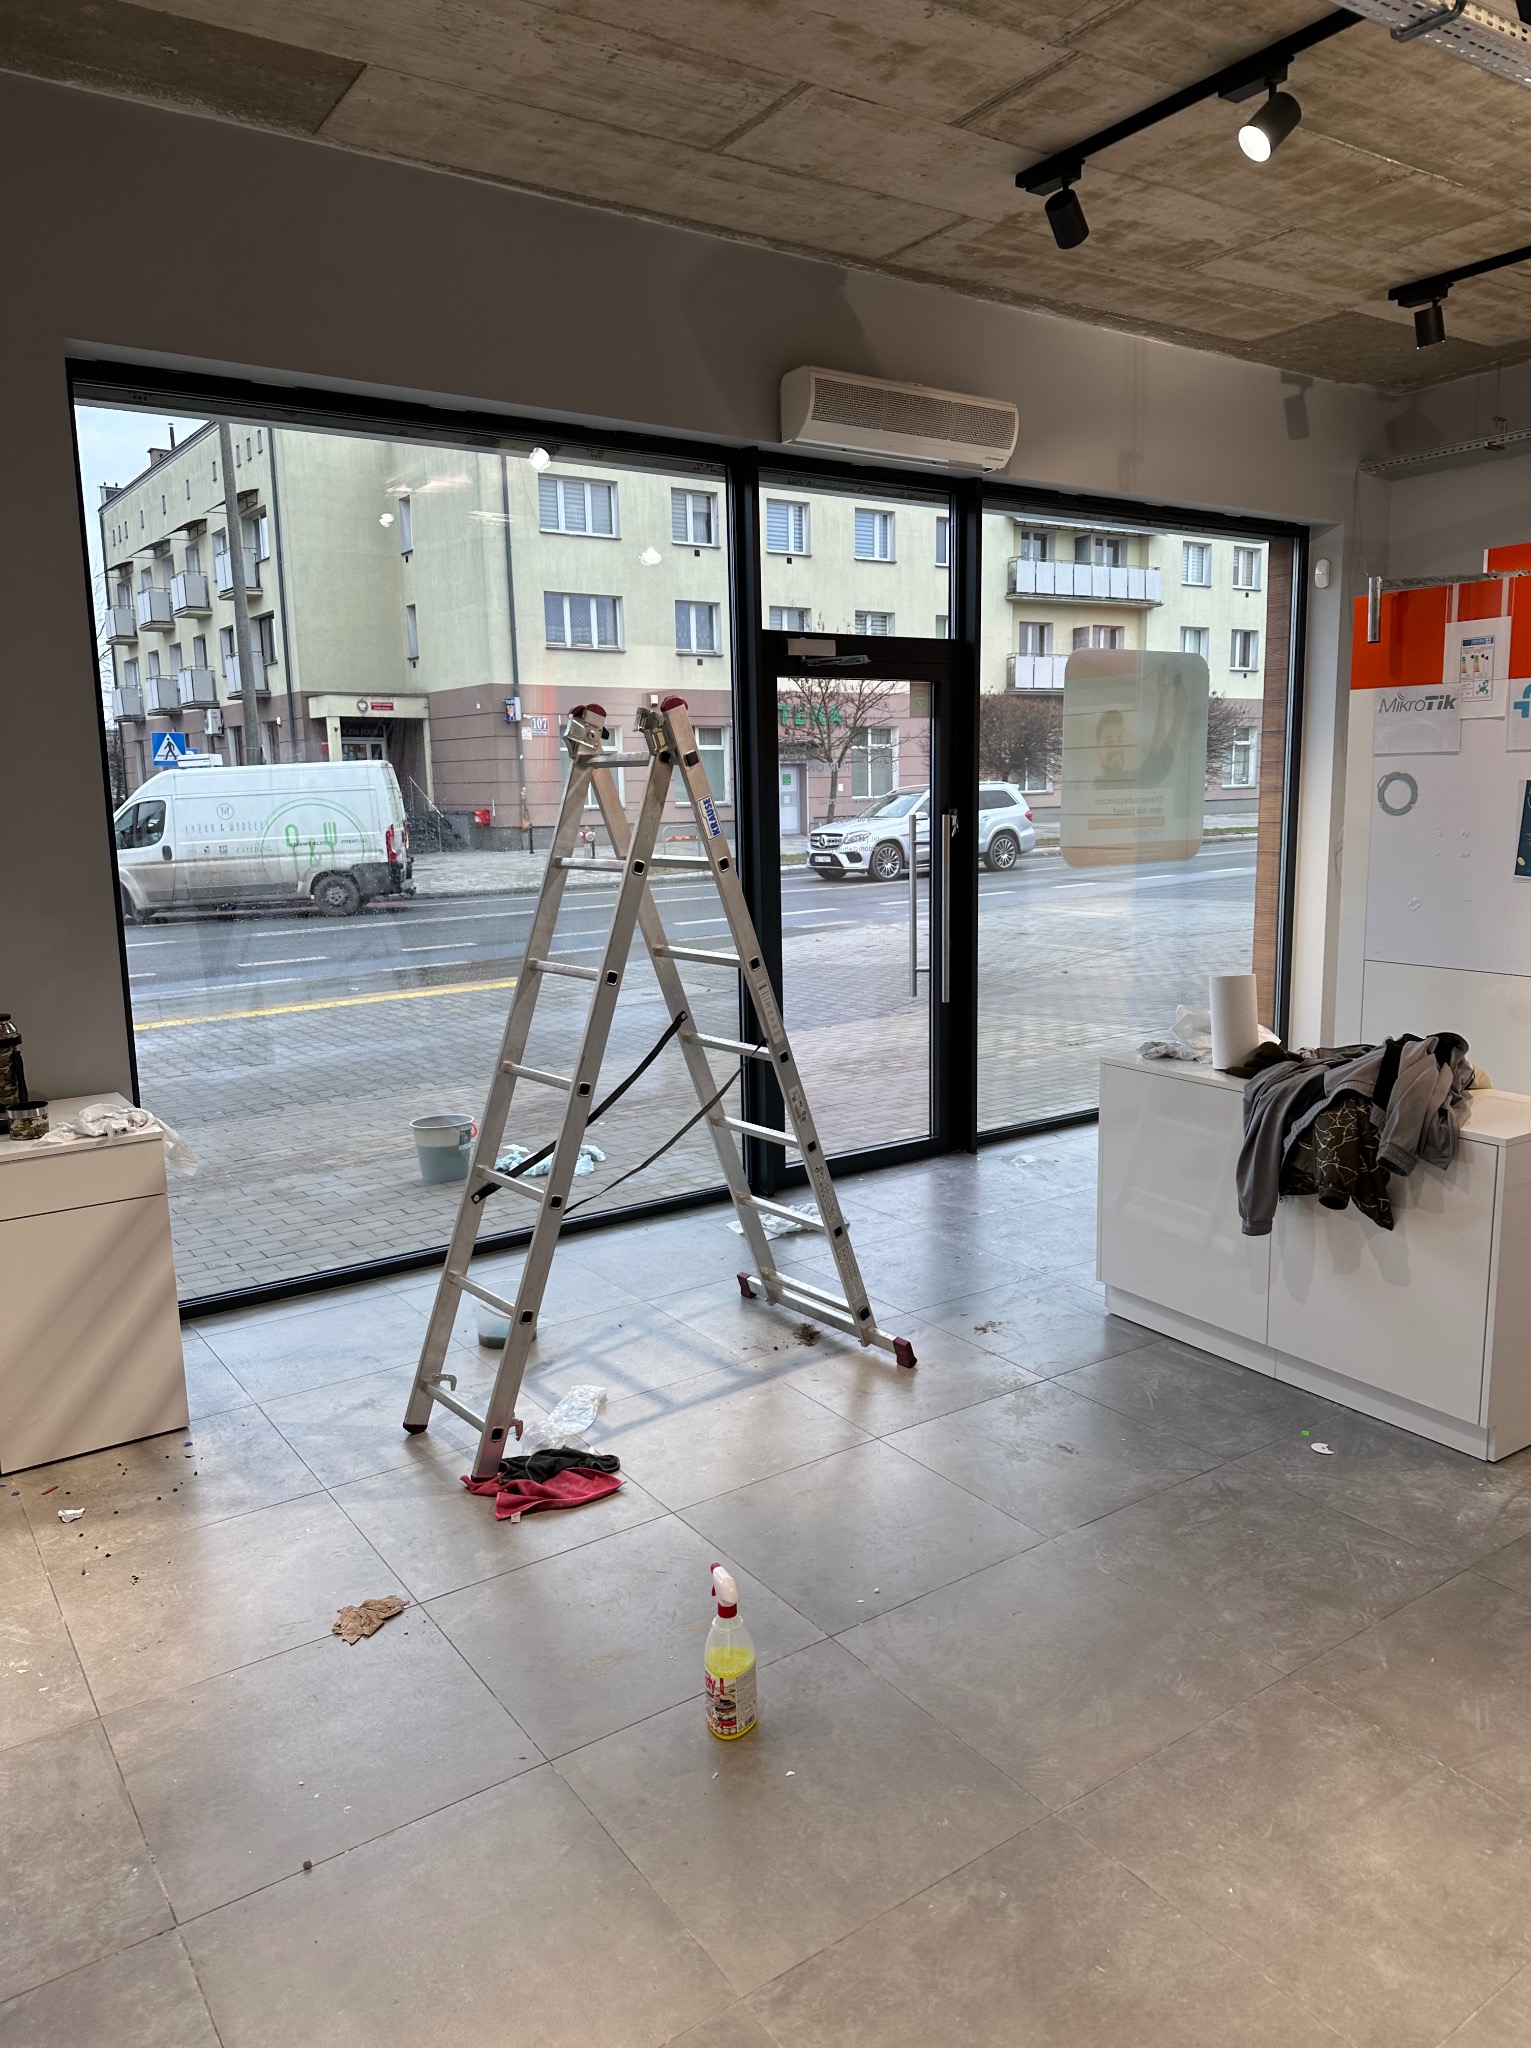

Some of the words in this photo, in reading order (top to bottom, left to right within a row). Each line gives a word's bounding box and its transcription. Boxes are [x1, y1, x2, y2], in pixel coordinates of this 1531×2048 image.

[1379, 694, 1457, 713] MikroTik
[532, 717, 548, 729] 107
[777, 703, 843, 725] TEKA
[703, 797, 721, 837] KRAUSE
